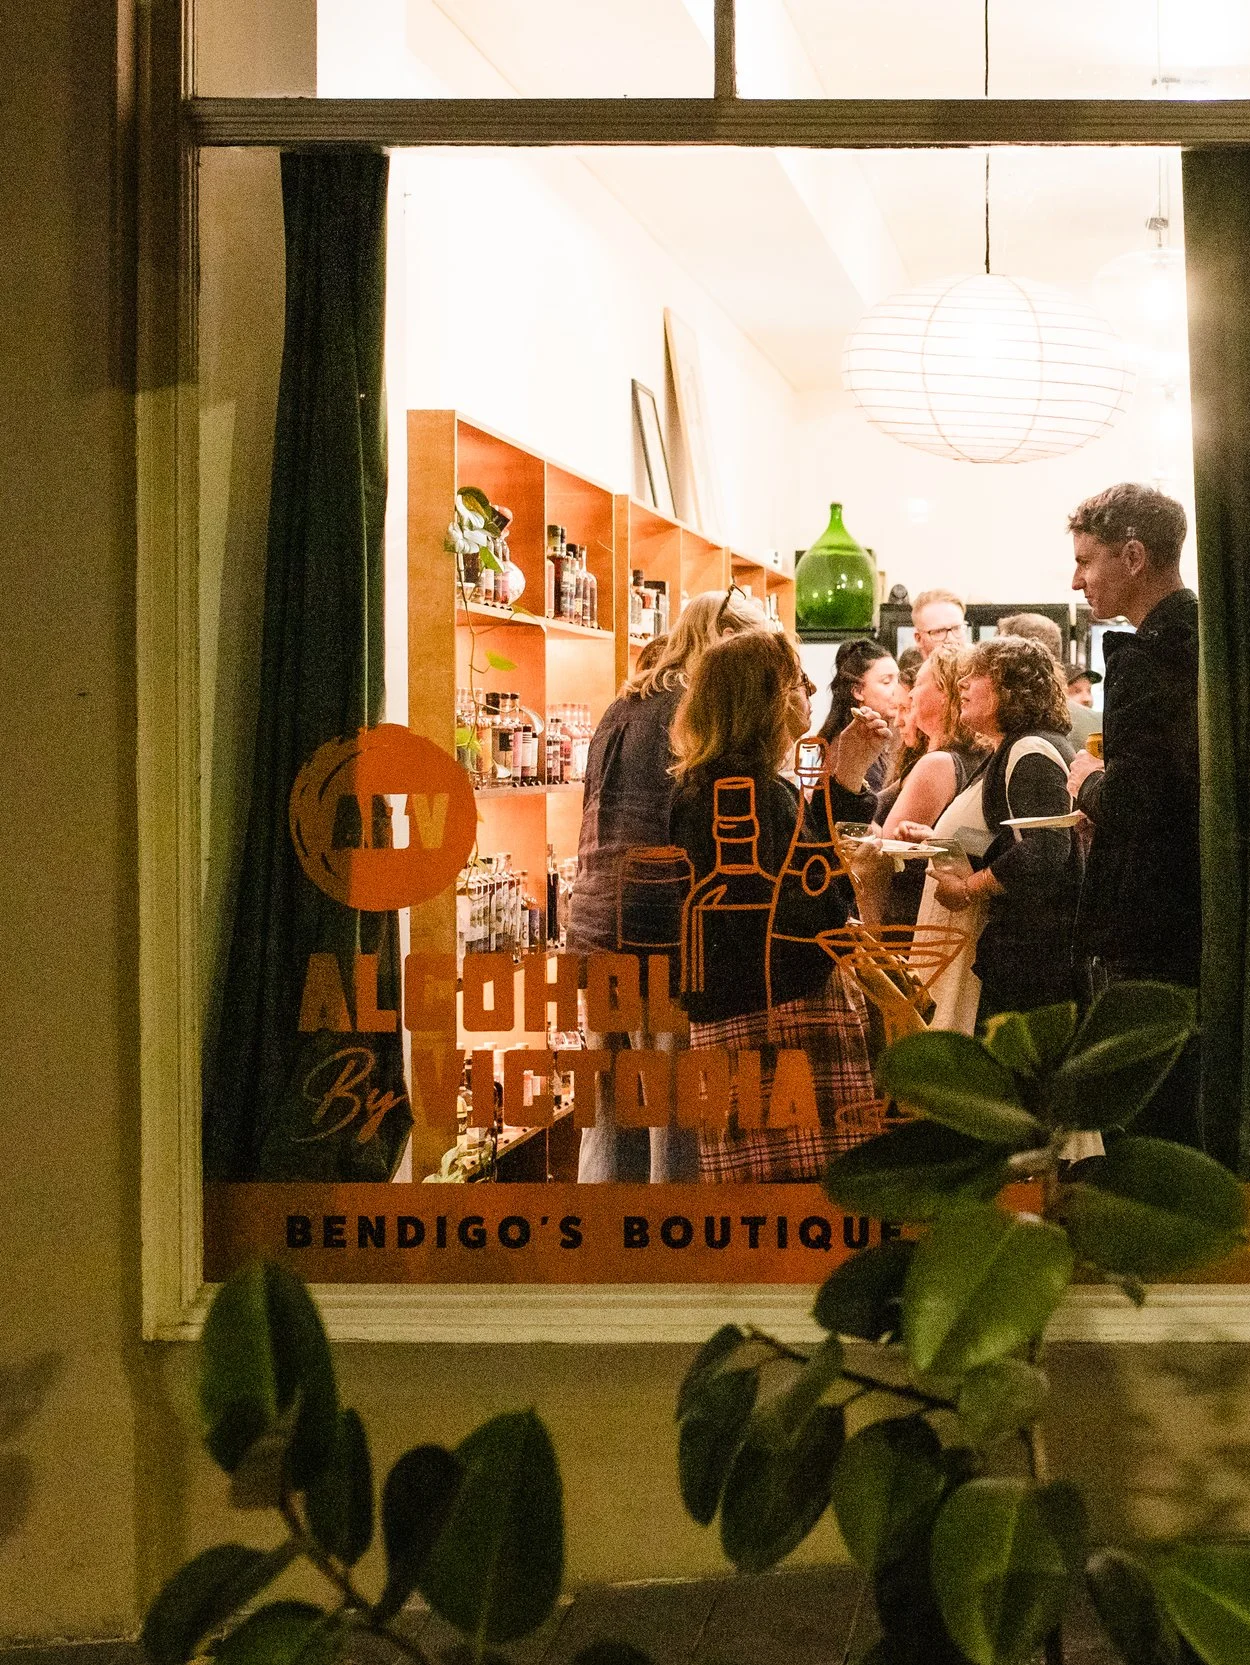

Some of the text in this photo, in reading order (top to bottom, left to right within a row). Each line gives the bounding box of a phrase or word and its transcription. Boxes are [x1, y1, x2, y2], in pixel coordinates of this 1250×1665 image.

[331, 793, 449, 850] ABV
[297, 952, 689, 1033] ALCOHOL
[291, 1046, 822, 1143] By VICTORIA
[286, 1215, 583, 1249] BENDIGO'S
